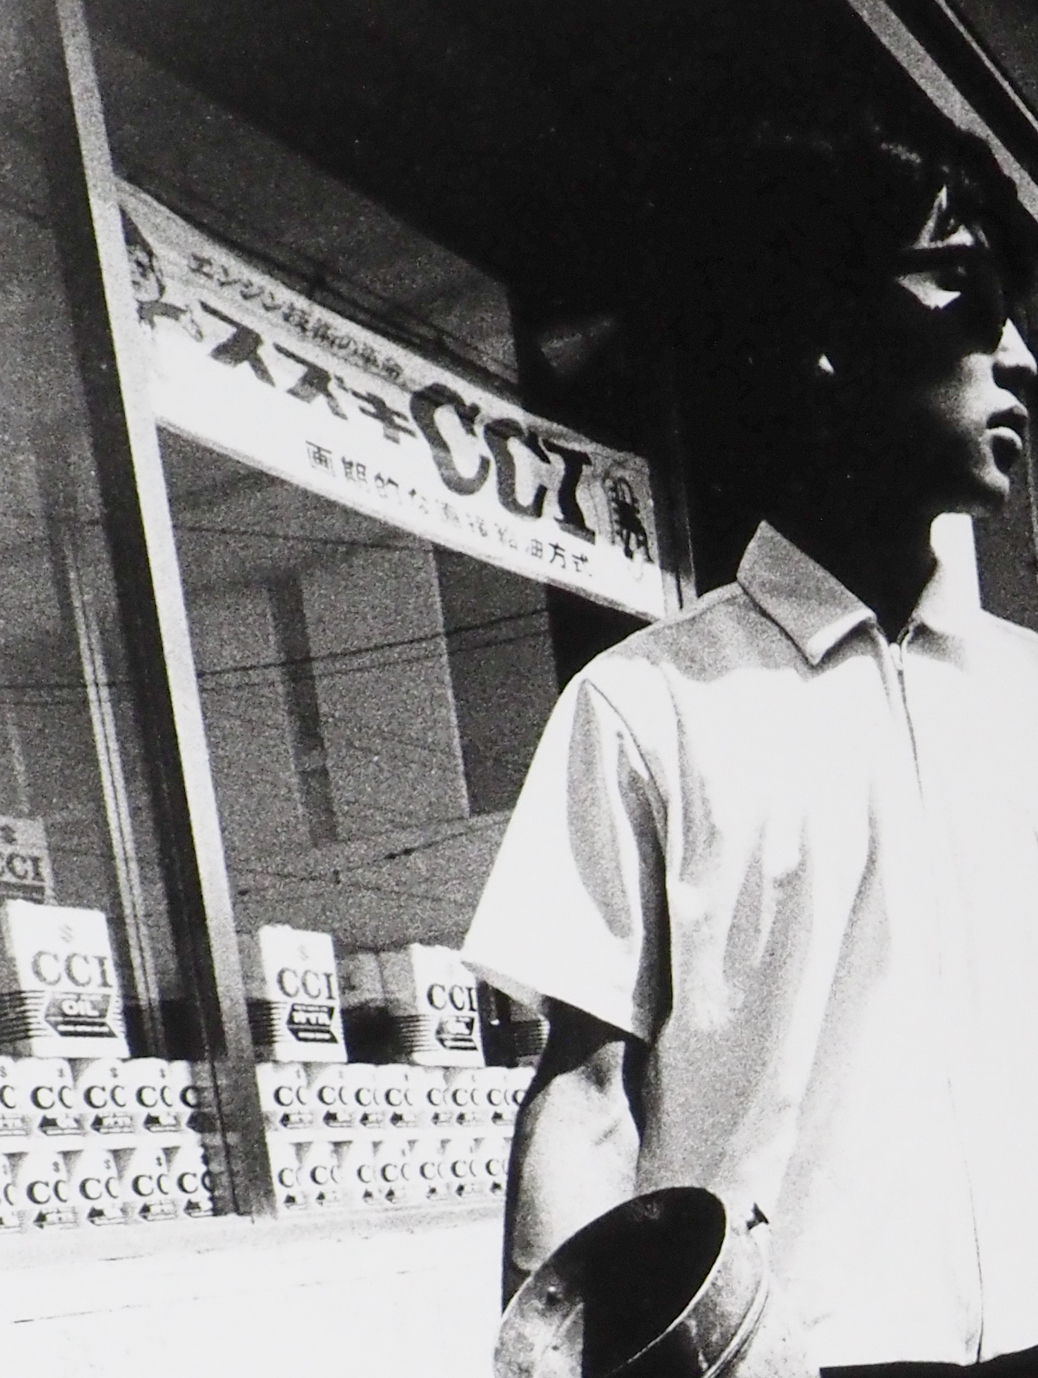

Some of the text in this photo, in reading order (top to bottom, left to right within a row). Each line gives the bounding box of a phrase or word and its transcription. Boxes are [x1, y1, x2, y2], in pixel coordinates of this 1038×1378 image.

[199, 300, 595, 543] スズキ CCI
[0, 851, 44, 882] CI
[31, 950, 113, 988] CCI
[276, 967, 337, 1000] CCI
[62, 1000, 99, 1017] OIL
[427, 983, 478, 1012] CCI
